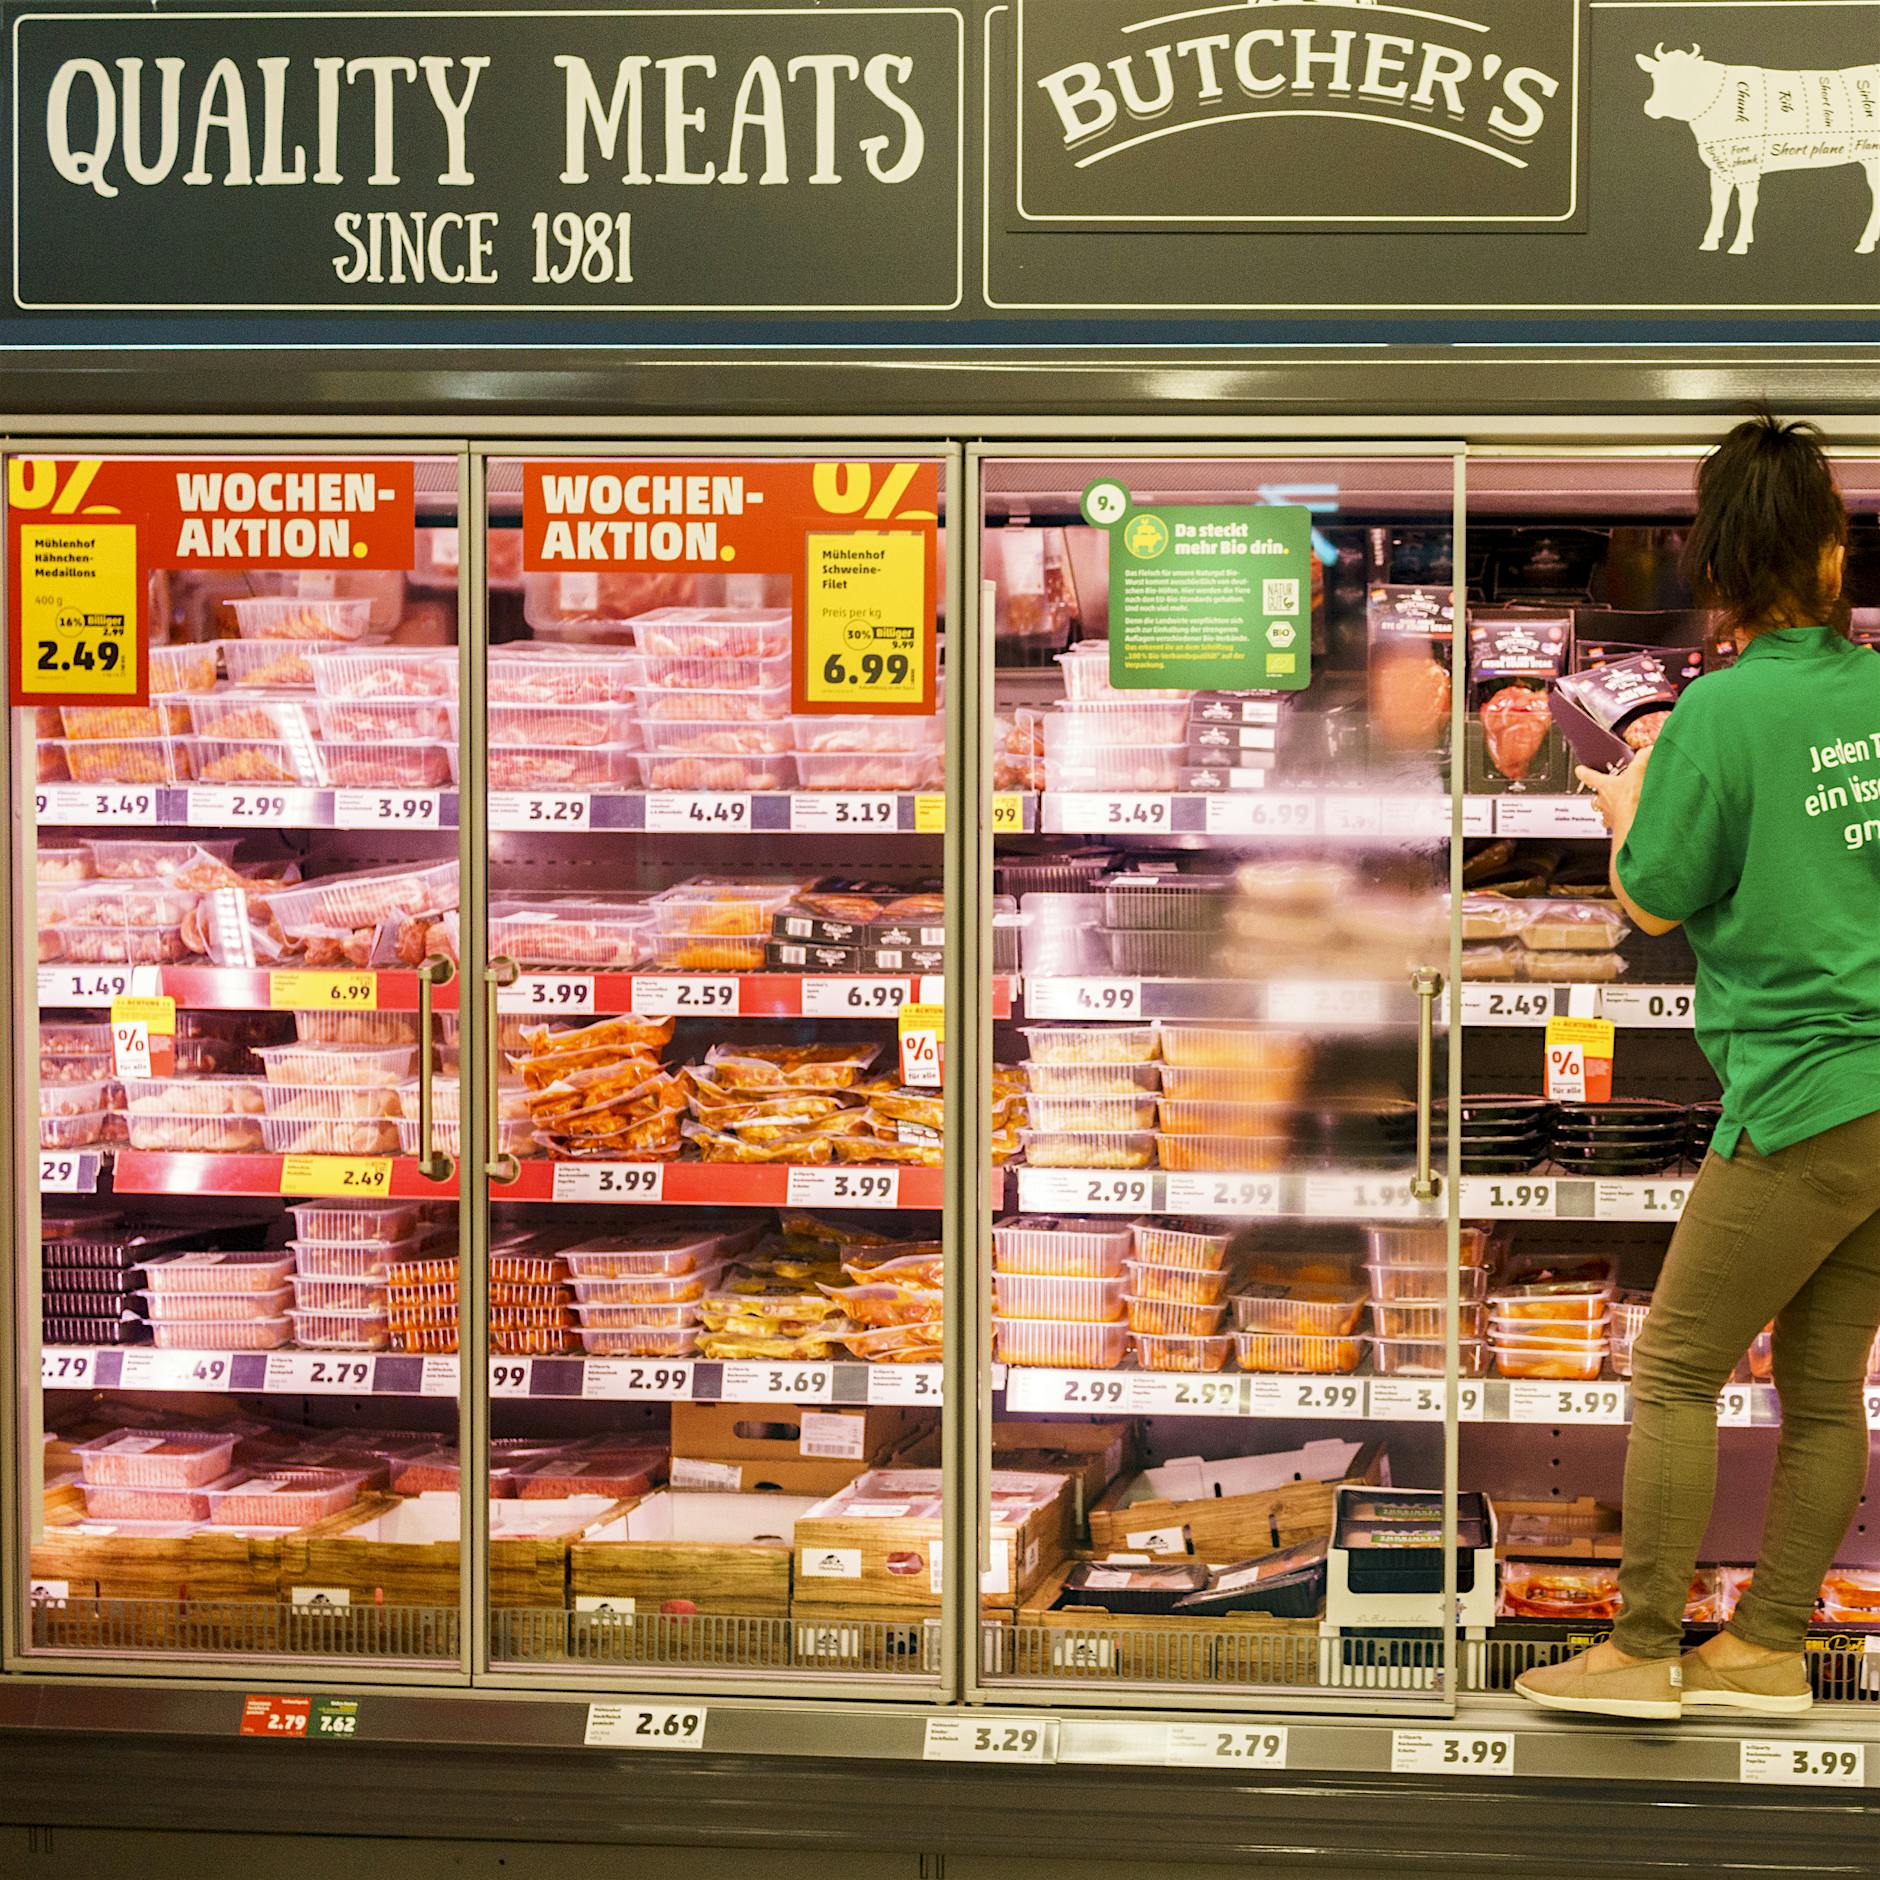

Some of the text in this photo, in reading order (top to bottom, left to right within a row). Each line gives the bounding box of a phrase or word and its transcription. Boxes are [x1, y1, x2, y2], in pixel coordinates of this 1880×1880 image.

[1037, 29, 1560, 146] BUTCHER'S
[1819, 76, 1831, 106] Short
[1778, 90, 1794, 112] Rib
[45, 54, 925, 197] QUALITY MEATS
[1770, 142, 1806, 156] Short
[332, 211, 633, 284] SINCE 1981
[176, 473, 395, 512] WOCHEN-
[541, 475, 764, 515] WOCHEN-
[1097, 496, 1115, 512] 9.
[176, 519, 368, 558] AKTION.
[1174, 523, 1249, 538] Da steckt
[35, 539, 95, 549] Mühlenhof
[541, 521, 736, 562] AKTION.
[1174, 539, 1290, 555] mehr Bio drin.
[35, 554, 94, 563] Hähnchen-
[822, 550, 885, 560] Mühlenhof
[35, 568, 96, 577] Medaillons
[822, 565, 881, 574] Schweine-
[822, 580, 847, 589] Filet
[822, 608, 881, 619] Preis per kg
[847, 630, 871, 639] 30%
[38, 641, 119, 671] 2.49
[824, 654, 909, 684] 6.99
[97, 796, 149, 814] 3.49
[232, 797, 286, 816] 2.99
[379, 800, 433, 818] 3.99
[530, 801, 584, 820] 3.29
[1804, 784, 1848, 817] ein
[690, 803, 744, 822] 4.49
[836, 803, 890, 822] 3.19
[1108, 803, 1165, 823] 3.49
[1251, 803, 1311, 825] 6.99
[72, 977, 125, 995] 1.49
[330, 986, 370, 1000] 6.99
[533, 984, 588, 1003] 3.99
[678, 986, 733, 1005] 2.59
[847, 987, 904, 1007] 6.99
[1076, 989, 1134, 1008] 4.99
[1490, 995, 1548, 1015] 2.49
[343, 1171, 385, 1186] 2.49
[599, 1171, 657, 1191] 3.99
[834, 1177, 892, 1197] 3.99
[1087, 1181, 1145, 1201] 2.99
[1214, 1183, 1273, 1204] 2.99
[1354, 1185, 1411, 1206] 1.99
[1490, 1186, 1549, 1206] 1.99
[310, 1363, 368, 1383] 2.79
[629, 1369, 687, 1389] 2.99
[768, 1372, 826, 1392] 3.69
[914, 1375, 942, 1395] 3.
[1065, 1381, 1123, 1402] 2.99
[1174, 1383, 1235, 1404] 2.99
[1297, 1386, 1357, 1407] 2.99
[1417, 1390, 1477, 1411] 3.9
[1557, 1392, 1618, 1413] 3.99
[267, 1713, 306, 1730] 2.79
[320, 1716, 356, 1732] 7.62
[636, 1713, 698, 1736] 2.69
[974, 1728, 1038, 1752] 3.29
[1216, 1733, 1280, 1757] 2.79
[1443, 1740, 1507, 1763] 3.99
[1792, 1750, 1857, 1775] 3.99
